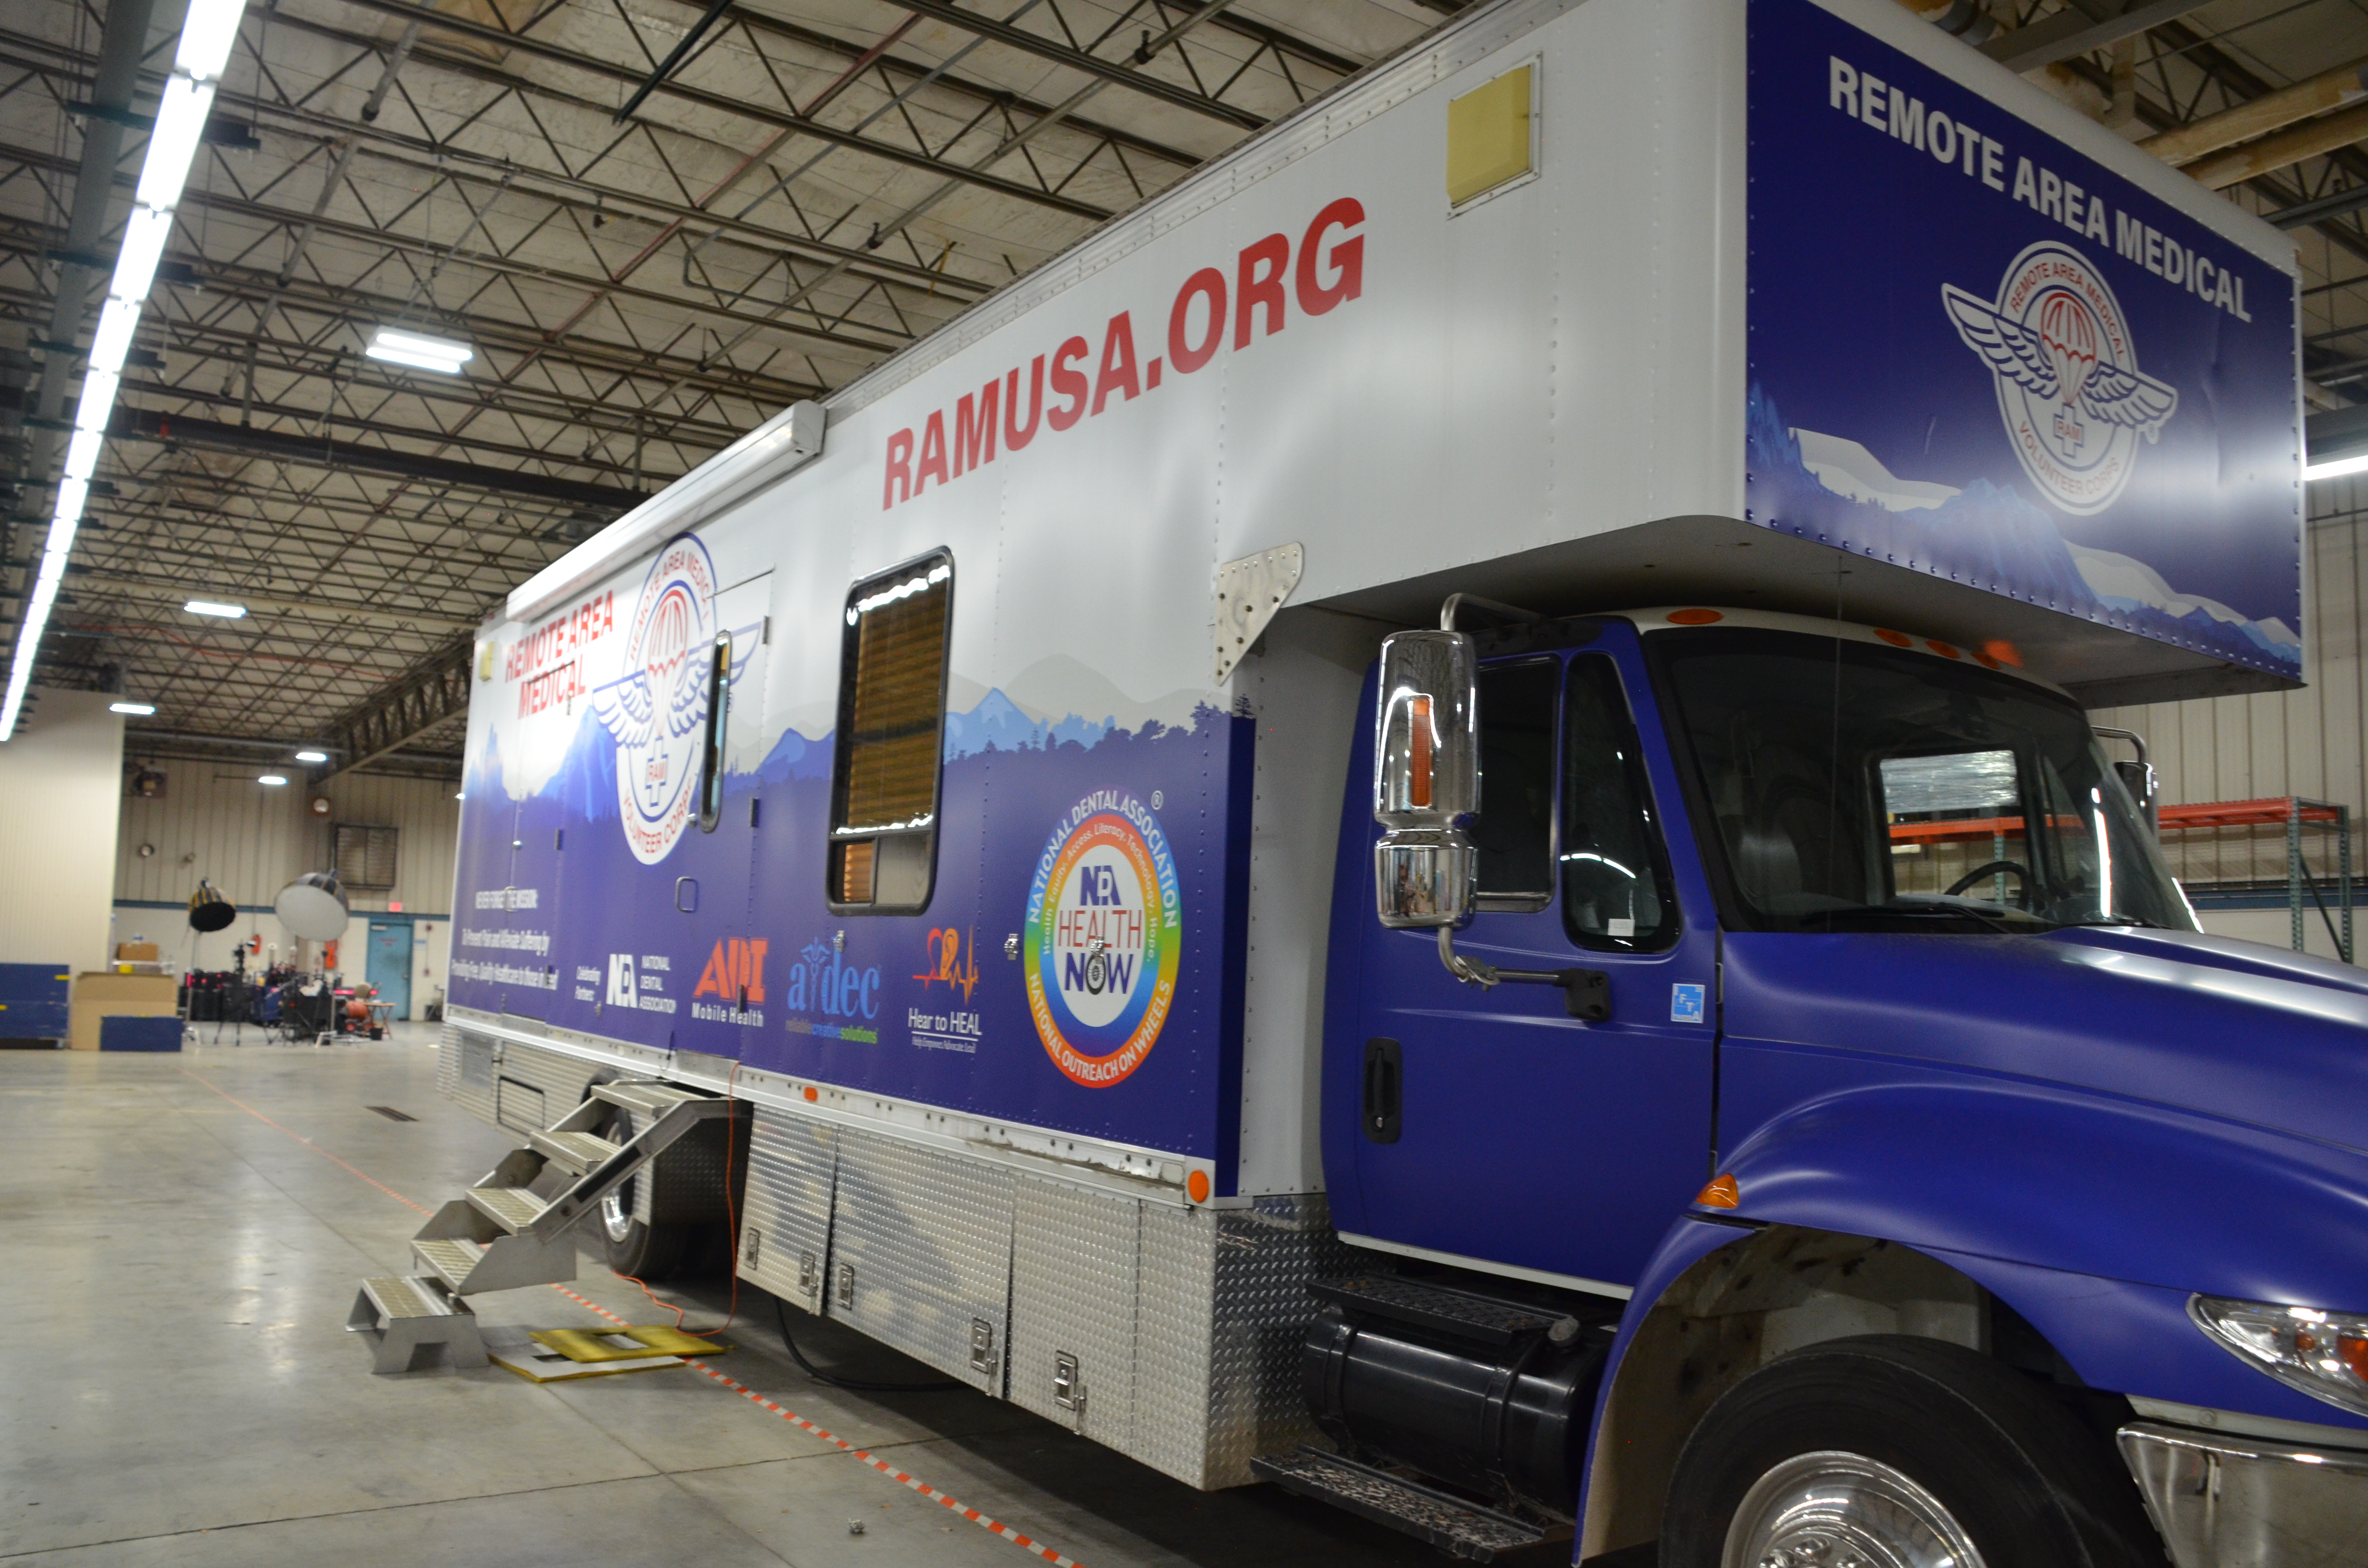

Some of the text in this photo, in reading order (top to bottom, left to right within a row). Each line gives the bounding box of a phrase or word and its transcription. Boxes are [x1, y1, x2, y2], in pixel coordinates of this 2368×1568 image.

[1829, 54, 2252, 323] REMOTE AREA MEDICAL
[2010, 262, 2124, 362] REMOTE AREA MEDICAL
[882, 196, 1366, 512] RAMUSA.ORG
[2056, 419, 2081, 442] RAM
[2019, 420, 2119, 495] VOLUNTEER CORPS
[630, 572, 661, 661] REMOTE
[662, 551, 685, 581] AREA
[505, 589, 613, 683] REMOTE AREA
[518, 653, 586, 720] MEDICAL
[648, 761, 665, 782] RAM
[1028, 790, 1178, 928] NATIONAL DENTAL ASSOCIATION
[1079, 865, 1122, 906] NDA
[1043, 908, 1053, 955] Health
[1058, 909, 1143, 949] HEALTH
[640, 975, 663, 991] DENTAL
[641, 955, 670, 971] NATIONAL
[1064, 952, 1134, 995] NOW
[691, 1003, 764, 1027] Mobile Health
[908, 1007, 983, 1036] Hear to HEAL
[1029, 972, 1171, 1081] NATIONAL OUTREACH ON WHEELS
